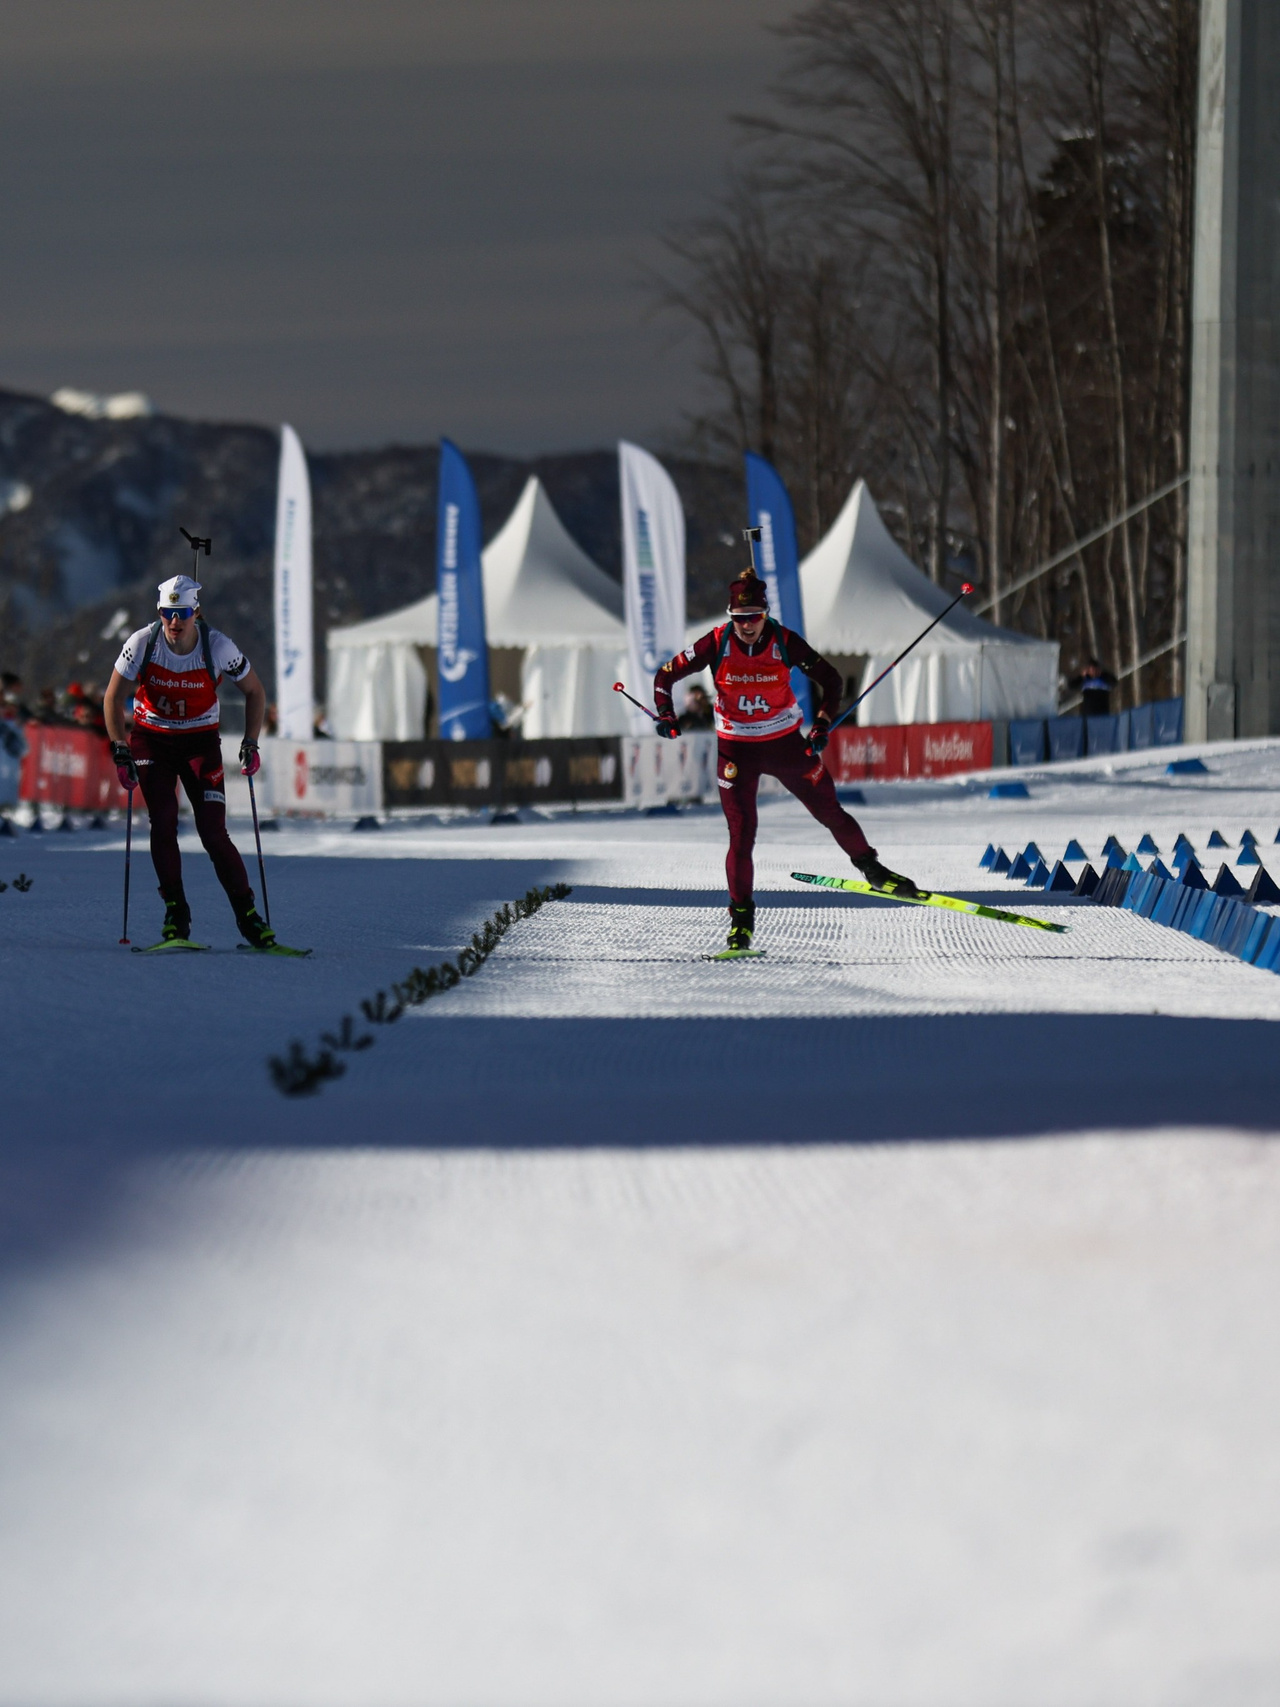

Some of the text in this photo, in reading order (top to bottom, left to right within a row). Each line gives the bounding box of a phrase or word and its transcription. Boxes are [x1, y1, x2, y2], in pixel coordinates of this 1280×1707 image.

[150, 675, 205, 689] Альфа Банк
[725, 673, 778, 685] Альфа Банк
[157, 695, 186, 717] 41
[738, 695, 771, 716] 44
